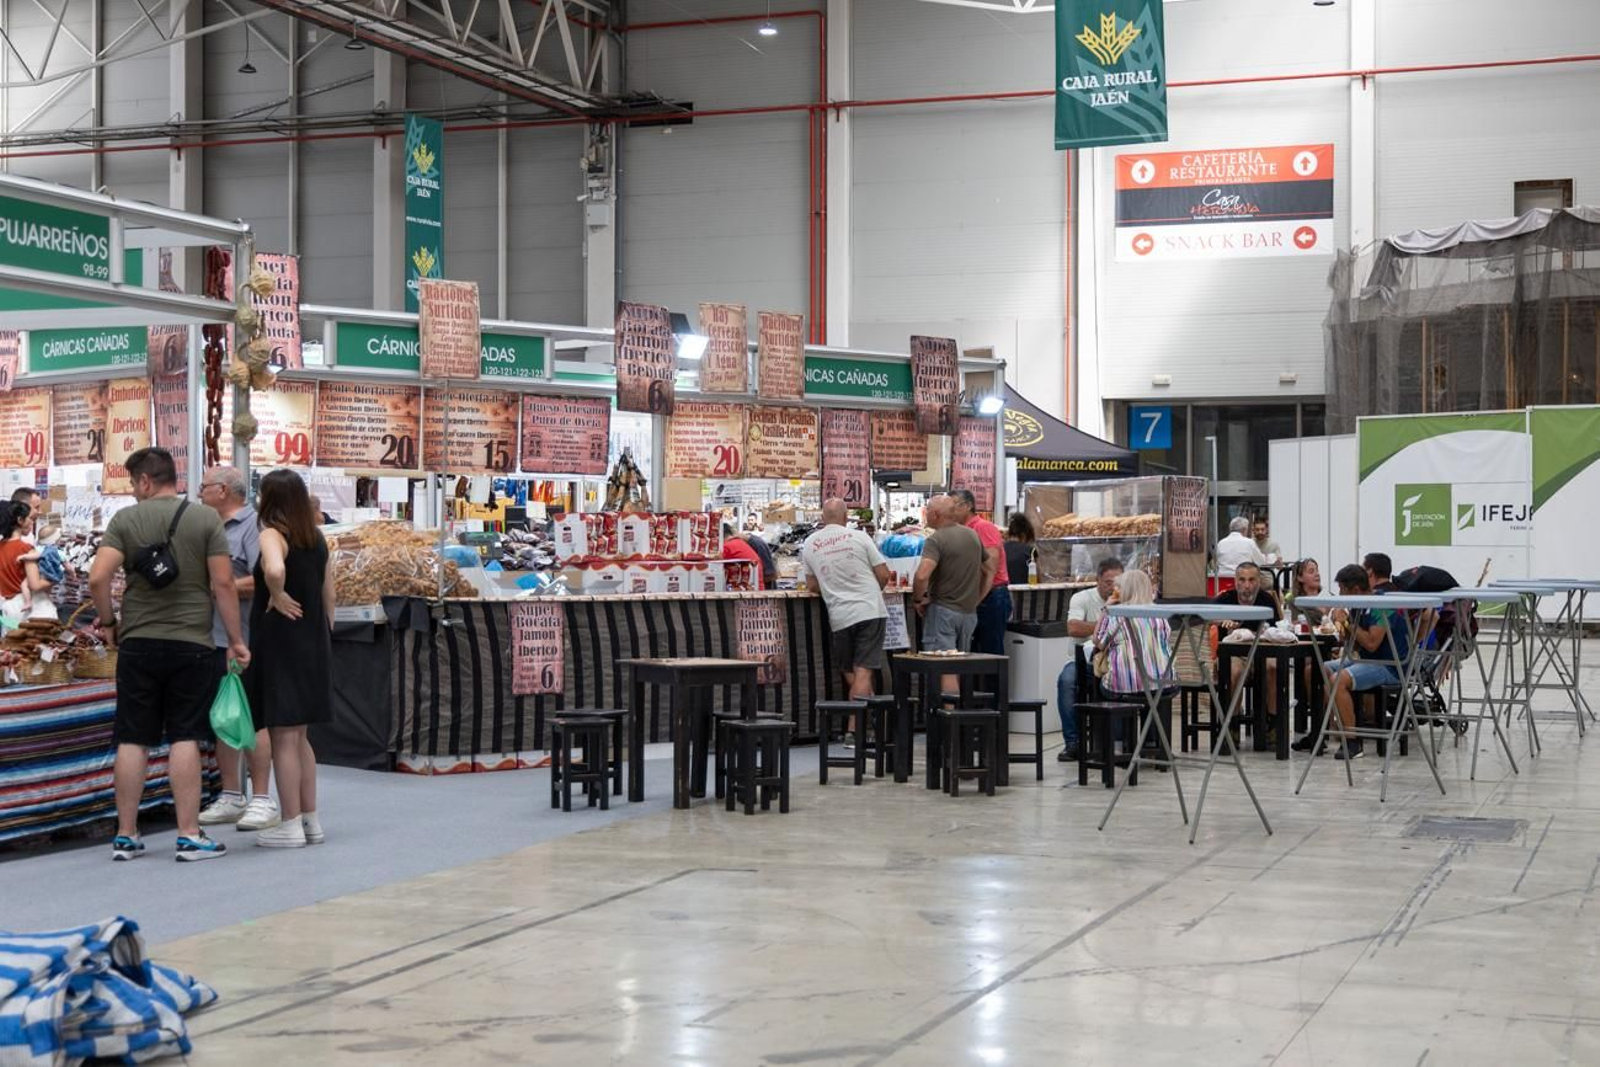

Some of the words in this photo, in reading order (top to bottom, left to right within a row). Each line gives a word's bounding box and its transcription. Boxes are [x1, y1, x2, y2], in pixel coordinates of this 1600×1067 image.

[1062, 75, 1100, 90] CAJA
[1103, 69, 1158, 87] RURAL
[1090, 89, 1130, 107] JAÉN
[1181, 150, 1265, 168] CAFETERÍA
[1168, 163, 1278, 180] RESTAURANTE
[421, 176, 440, 190] RURAL
[1202, 188, 1243, 210] Casa
[1165, 234, 1238, 250] SNACK
[1242, 232, 1283, 249] BAR
[83, 263, 108, 278] 98-99
[425, 283, 475, 303] Raciones
[428, 301, 473, 320] Surtidas
[713, 308, 728, 325] Hay
[43, 337, 86, 358] CÁRNICAS
[87, 332, 129, 352] CAÑADAS
[764, 333, 799, 347] Surtidas
[716, 355, 737, 370] Agua
[837, 368, 889, 387] CAÑADAS
[111, 387, 149, 403] Embutidos
[112, 418, 146, 434] Ibericos
[1140, 412, 1162, 443] 7
[25, 432, 44, 465] 99
[123, 437, 135, 451] de
[275, 432, 310, 465] 99
[380, 434, 415, 466] 20
[484, 440, 510, 471] 15
[713, 445, 740, 475] 20
[1015, 456, 1118, 472] alamanca.com
[843, 480, 862, 502] 20
[520, 630, 556, 642] Jamon
[518, 645, 558, 657] Iberico
[541, 663, 554, 690] 6
